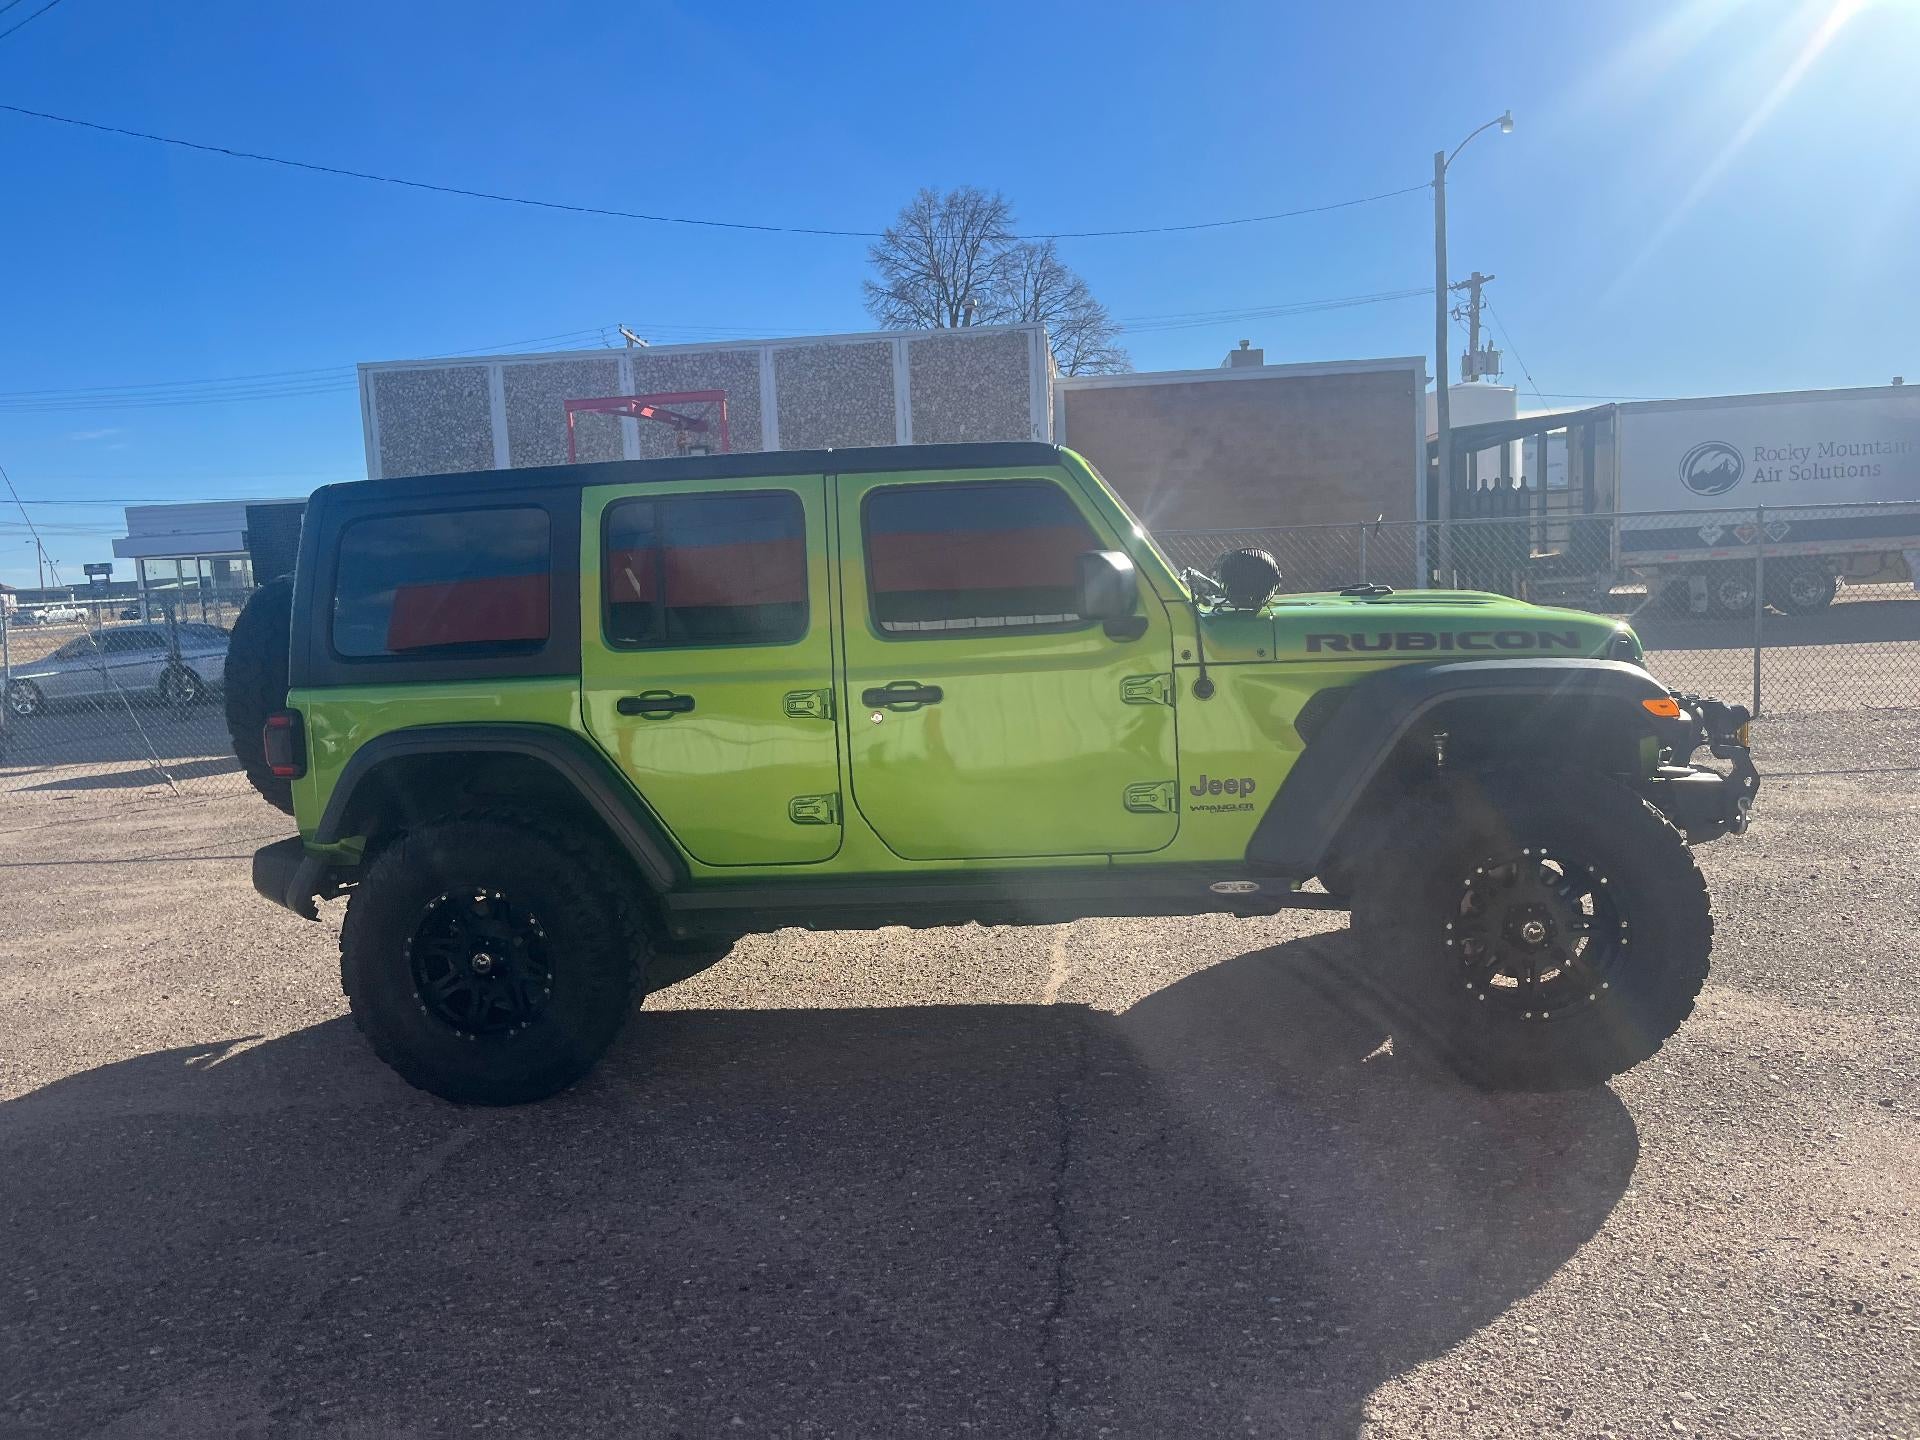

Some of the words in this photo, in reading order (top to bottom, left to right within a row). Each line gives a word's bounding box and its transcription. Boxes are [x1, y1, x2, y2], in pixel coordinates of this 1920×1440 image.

[1752, 443, 1810, 464] Rocky
[1752, 467, 1783, 483] Air
[1788, 463, 1881, 481] Solutions
[1305, 631, 1582, 652] RUBICON
[1189, 774, 1256, 798] Jeep
